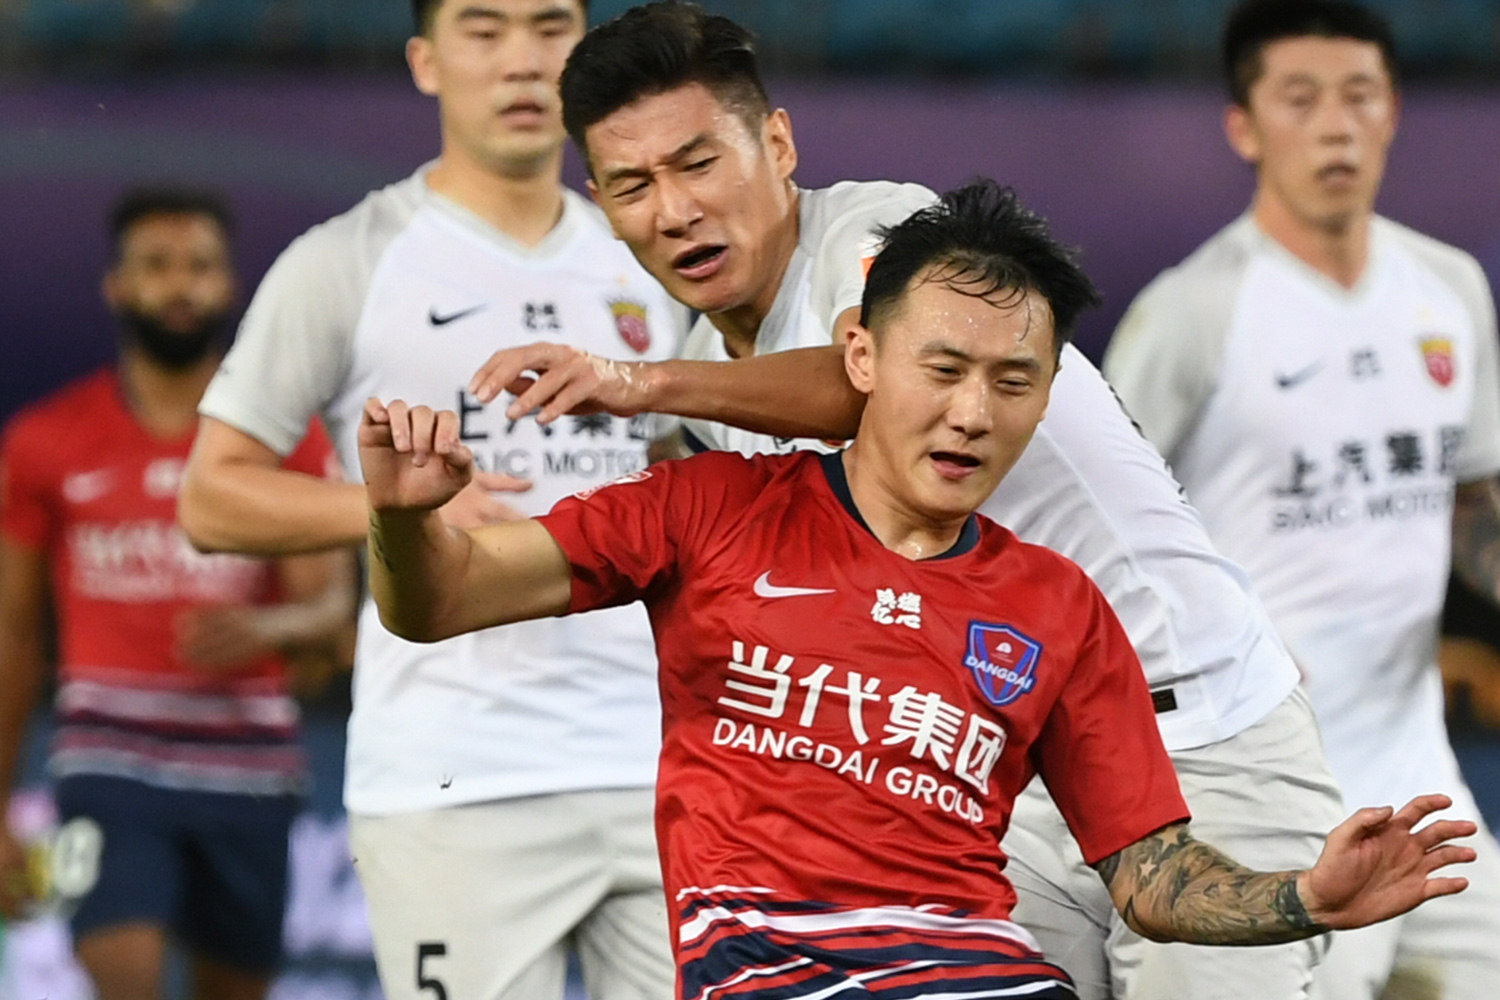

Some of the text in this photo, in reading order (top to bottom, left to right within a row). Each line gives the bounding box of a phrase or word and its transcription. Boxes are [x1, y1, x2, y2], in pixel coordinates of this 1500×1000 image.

[717, 640, 1007, 796] 当代集团
[963, 655, 1034, 690] DANGDAI
[712, 717, 985, 824] DANGDAI GROUP
